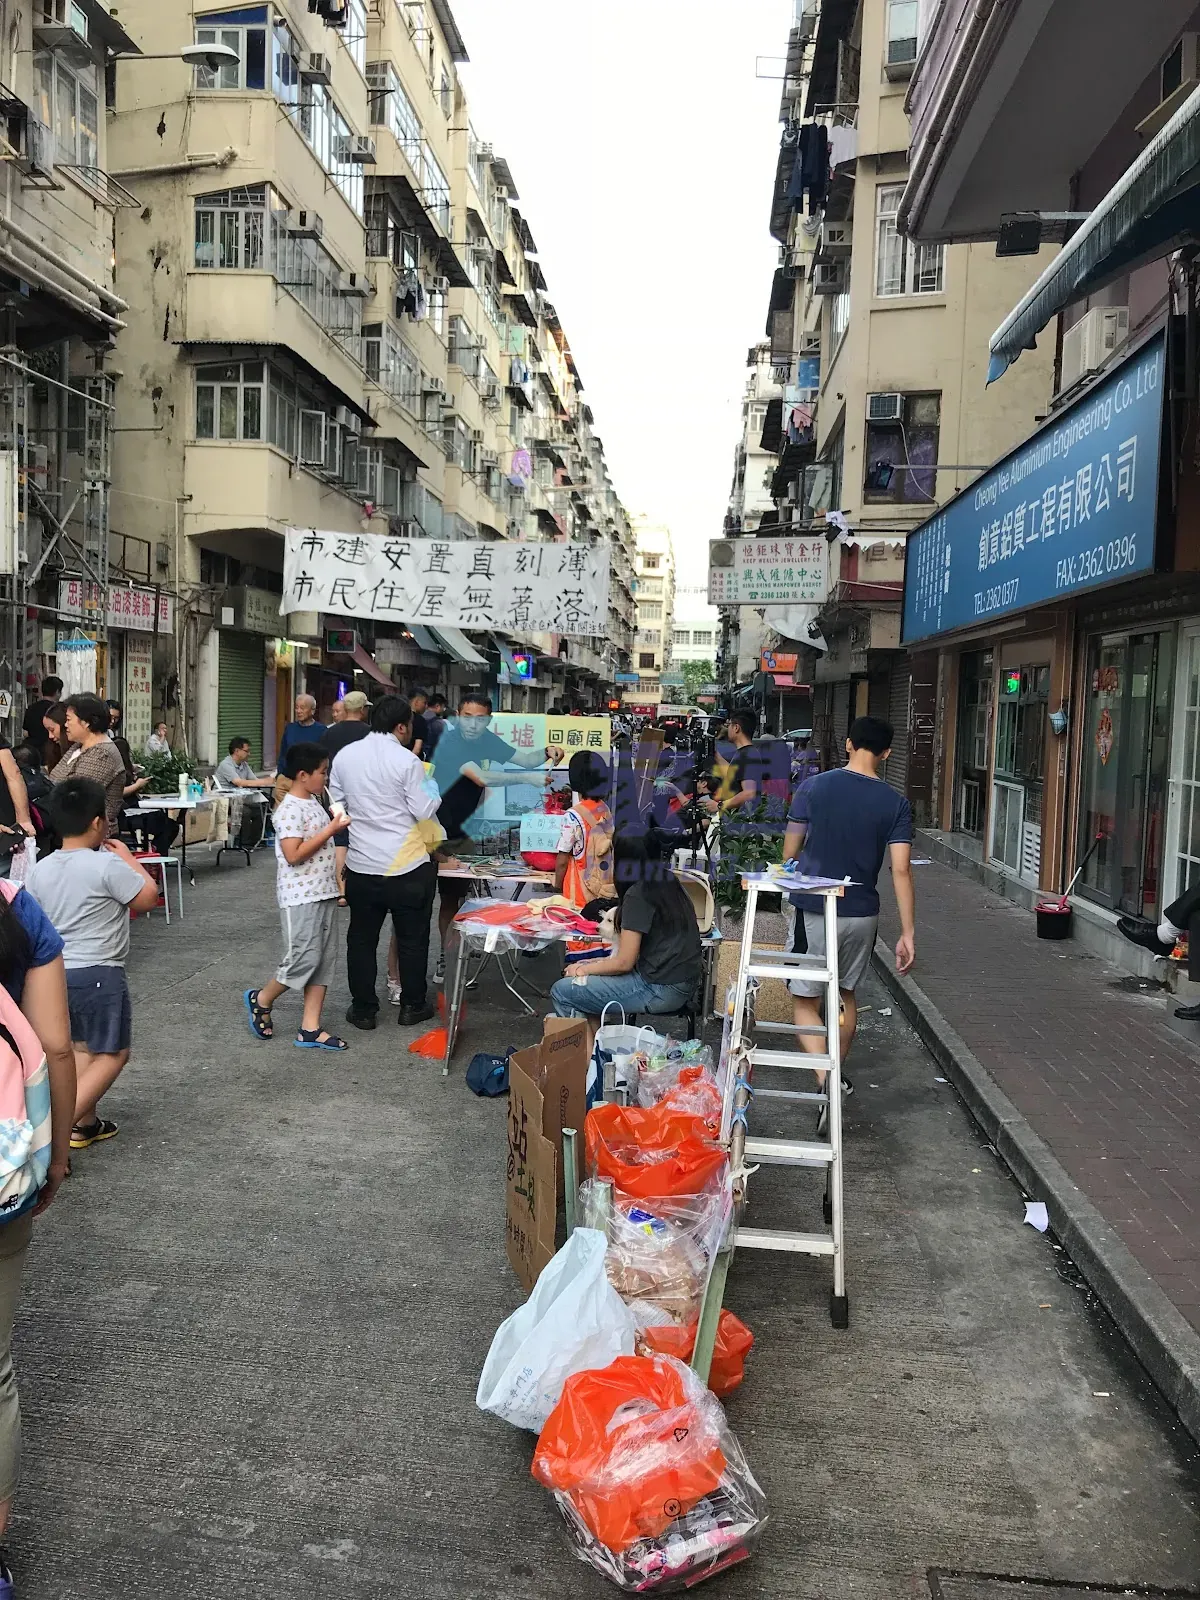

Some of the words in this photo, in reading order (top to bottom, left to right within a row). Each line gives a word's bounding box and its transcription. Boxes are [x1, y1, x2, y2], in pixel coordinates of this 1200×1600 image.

[974, 478, 997, 511] Cheong
[998, 469, 1010, 495] Yee
[1010, 442, 1051, 485] Aluminium
[1052, 396, 1112, 459] Engineering
[1114, 379, 1133, 413] Co.
[1136, 351, 1160, 400] Ltd
[977, 434, 1138, 572] 創意鋁質工程有限公司
[301, 530, 590, 580] 市建安置真刻薄
[743, 542, 822, 557] 恒鉅珠寶金行
[1055, 555, 1076, 589] FAX:
[1077, 546, 1104, 582] 2362
[1106, 532, 1137, 573] 0396
[293, 570, 590, 624] 市民住屋無著落
[776, 591, 790, 599] 1249
[973, 590, 986, 615] TEL:
[986, 585, 1001, 612] 2362
[1001, 577, 1020, 608] 0377
[128, 680, 151, 693] 大小工程
[548, 728, 603, 747] 回顧展
